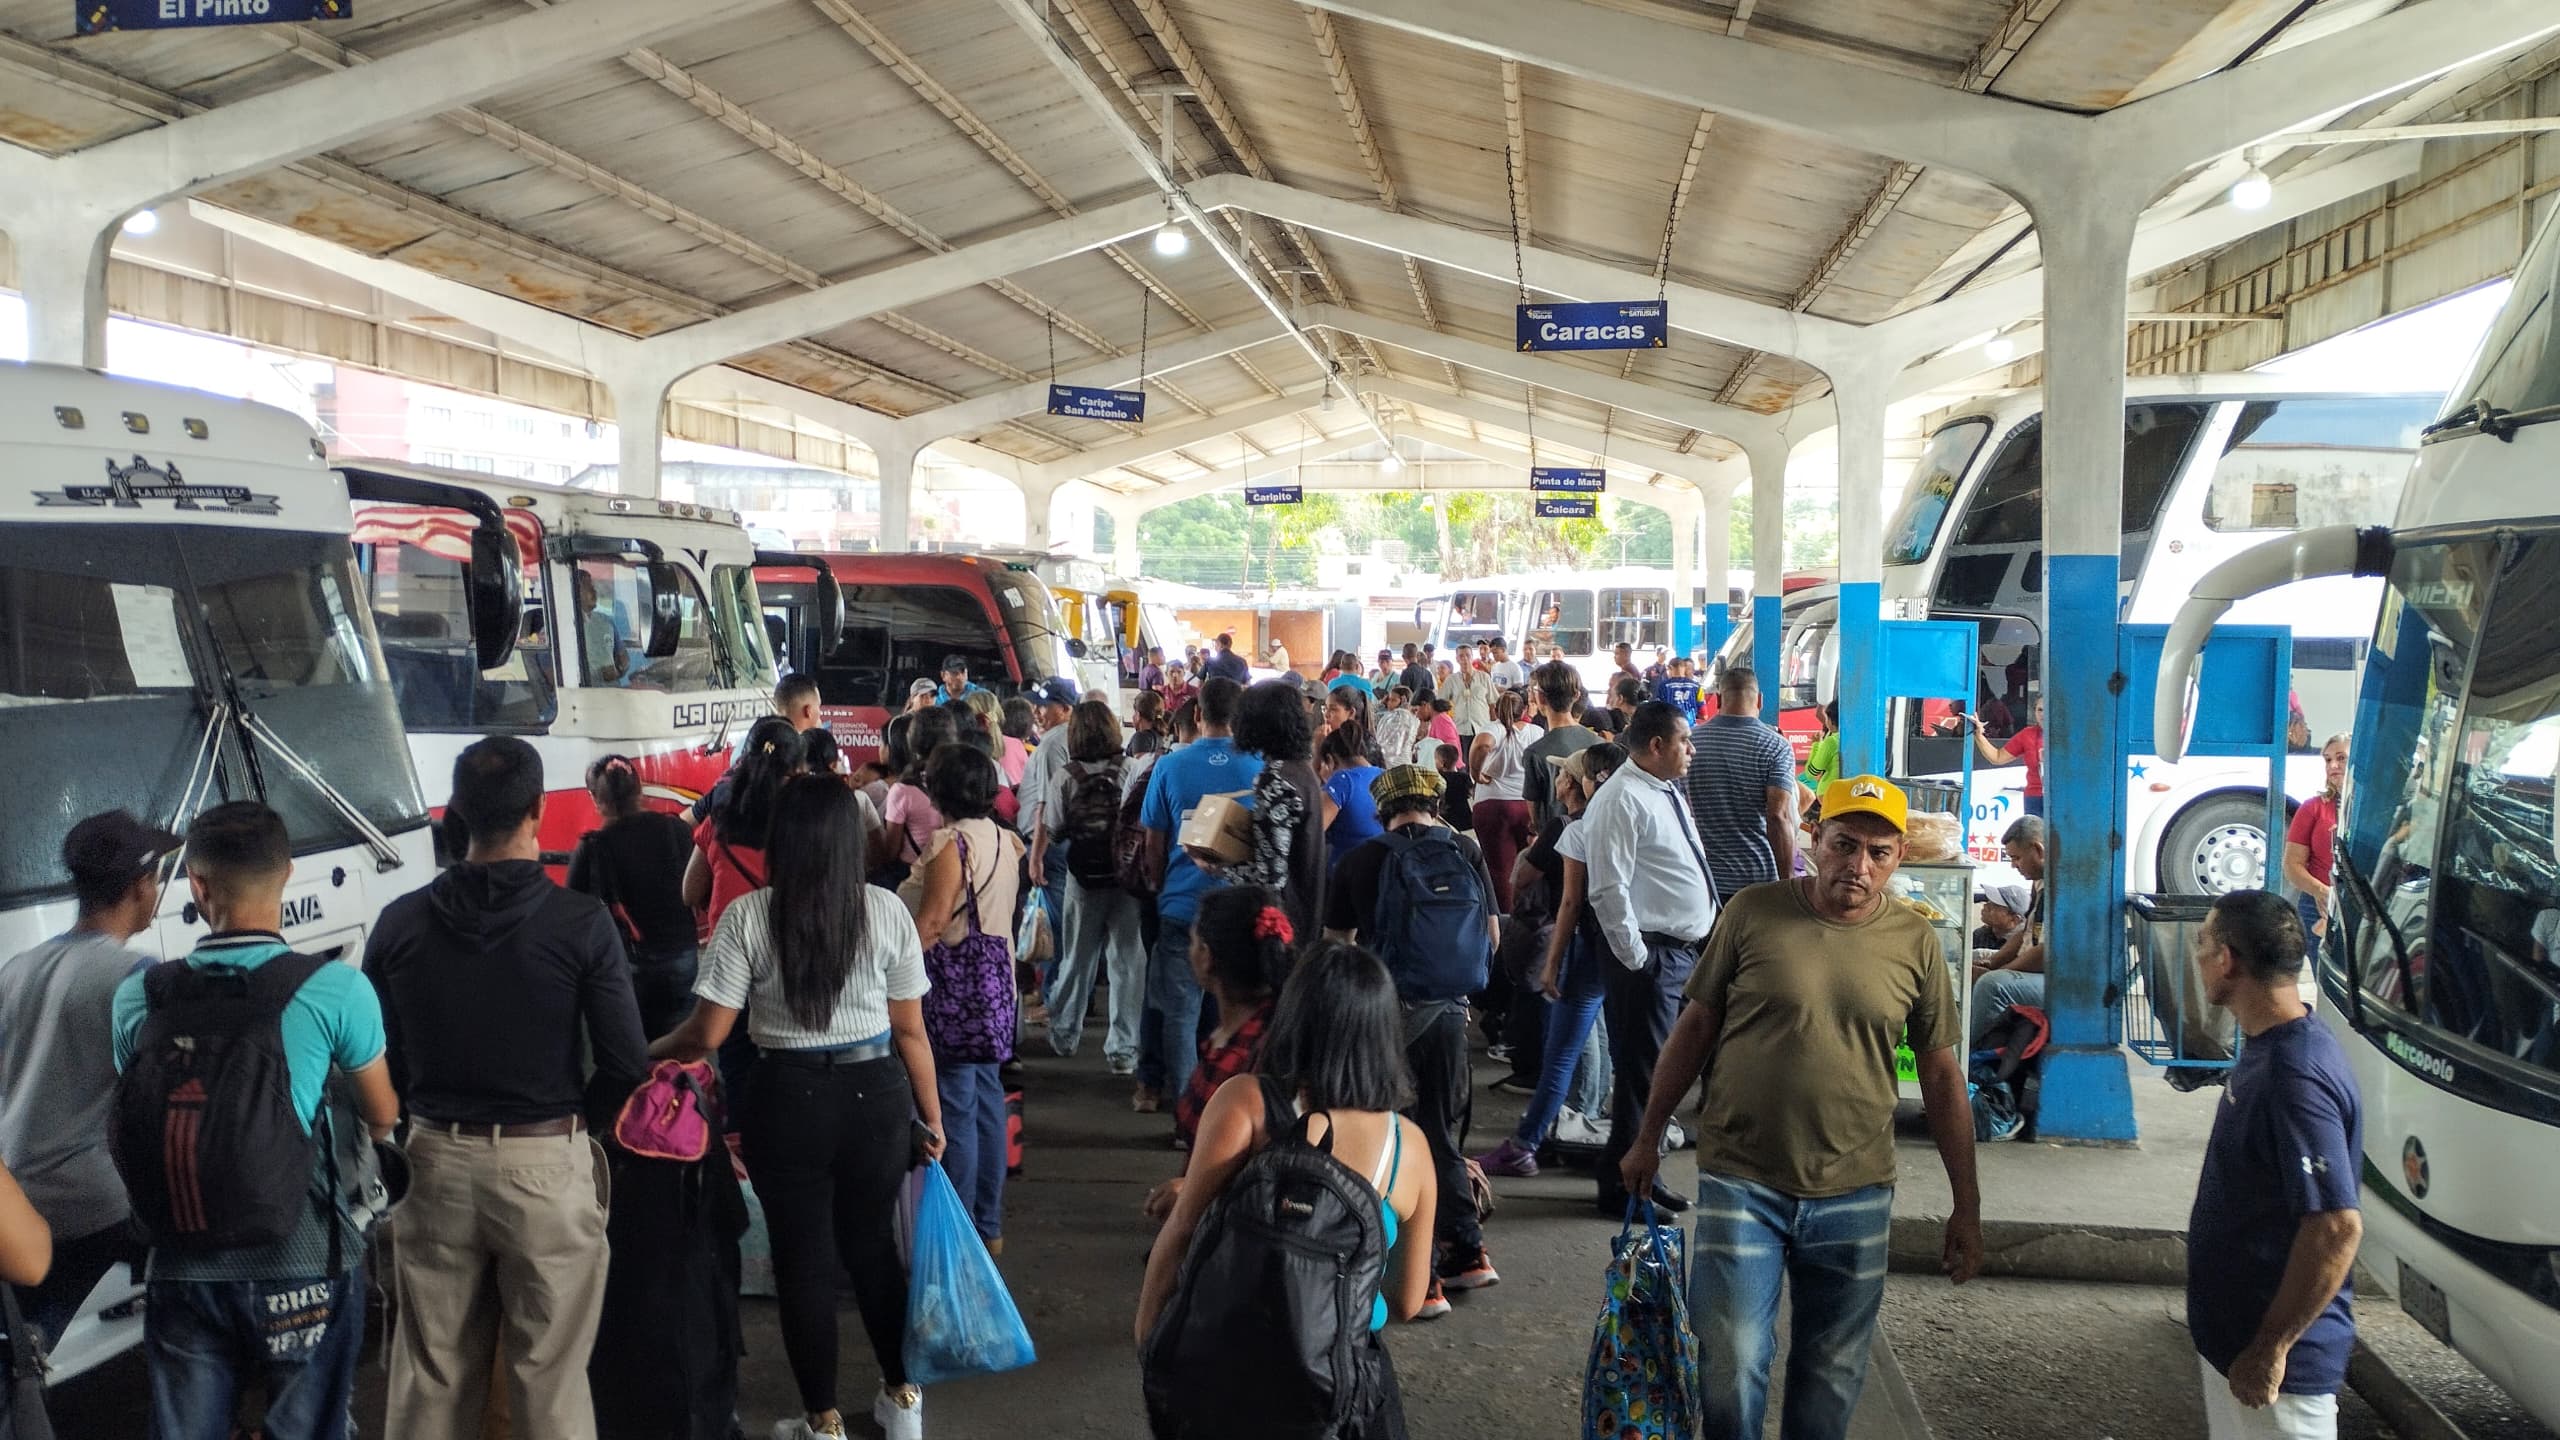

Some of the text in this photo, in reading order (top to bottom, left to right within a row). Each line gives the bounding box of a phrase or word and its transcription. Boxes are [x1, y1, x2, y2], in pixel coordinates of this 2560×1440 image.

[159, 0, 270, 18] El Pinto
[1540, 322, 1646, 342] Caracas
[1079, 396, 1114, 408] Caripo
[1064, 405, 1128, 418] San Antonio
[1532, 477, 1602, 486] Punta de Mata
[1252, 492, 1292, 503] Caripito
[1545, 505, 1586, 514] Caicara
[673, 703, 707, 729] LA
[2386, 1030, 2455, 1082] Marcopolo
